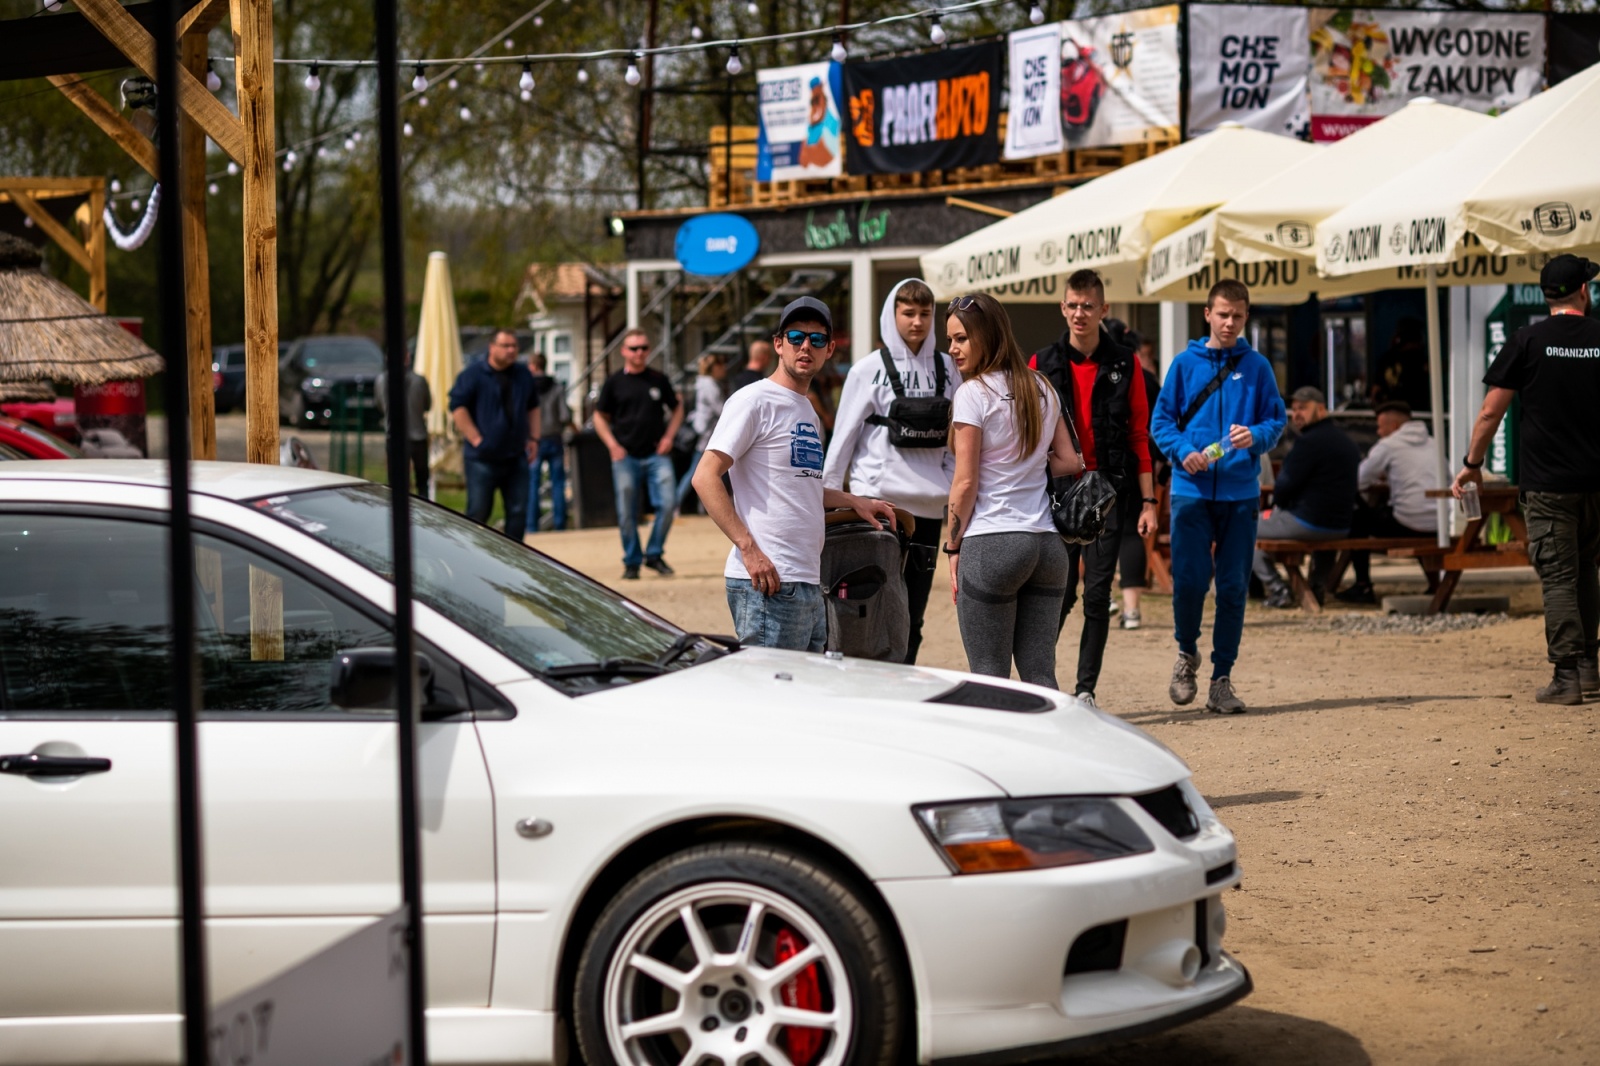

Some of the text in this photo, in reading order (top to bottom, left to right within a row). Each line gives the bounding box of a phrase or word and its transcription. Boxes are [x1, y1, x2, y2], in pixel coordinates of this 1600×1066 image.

[1221, 35, 1279, 59] CHE
[1390, 27, 1530, 57] WYGODNE
[1219, 61, 1280, 84] MOT
[1406, 65, 1517, 93] ZAKUPY
[1221, 86, 1269, 110] ION
[1521, 210, 1592, 231] 18 45
[1345, 217, 1446, 263] OKOCIM OKOCIM
[968, 226, 1121, 283] OKOCIM OKOCIM
[872, 368, 920, 389] ALHA
